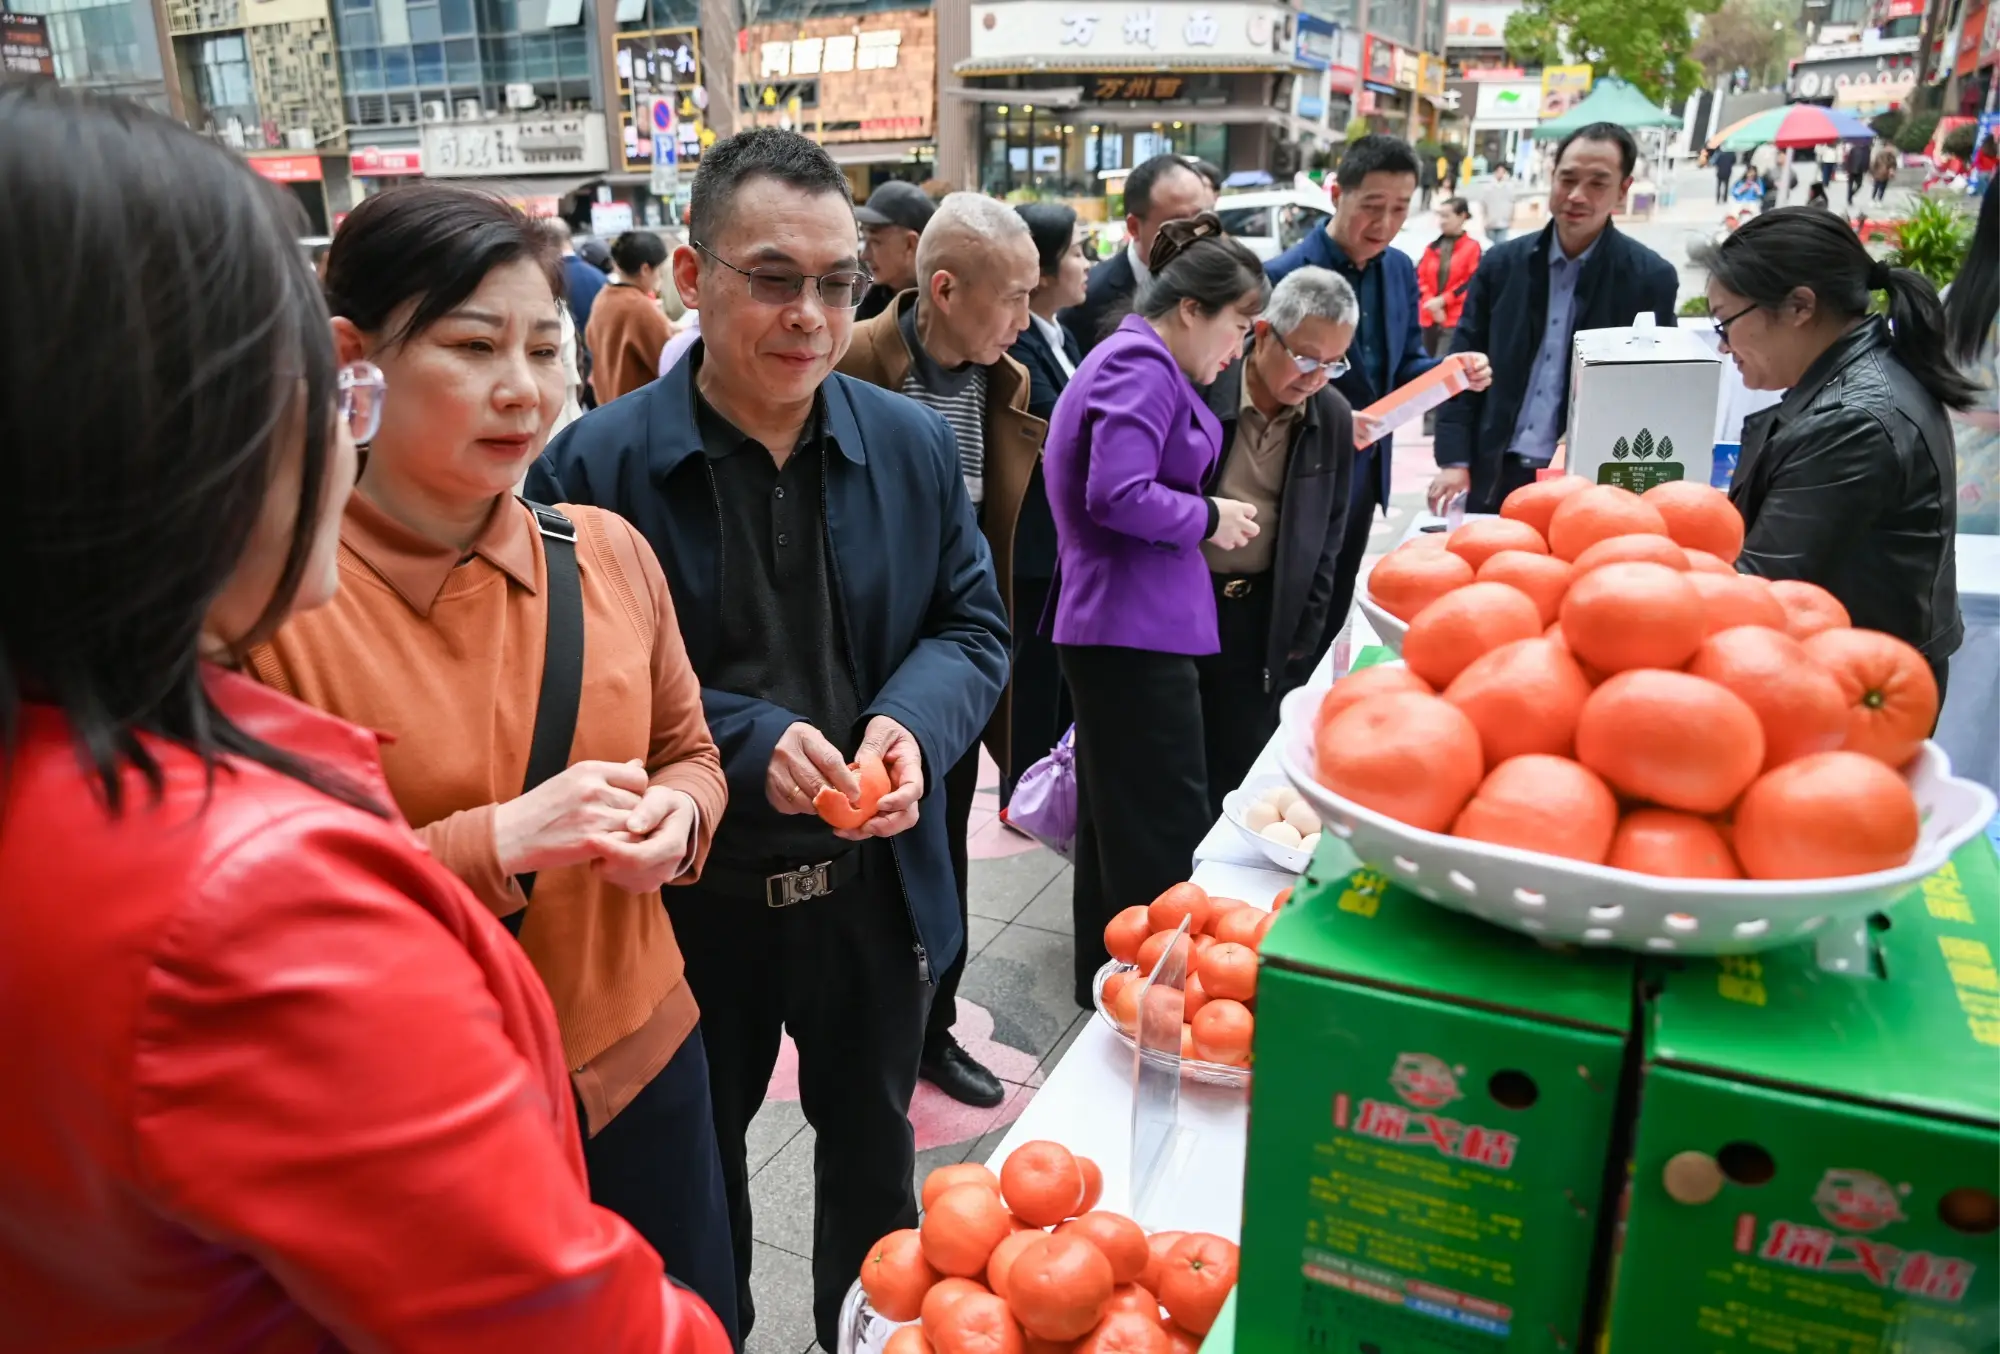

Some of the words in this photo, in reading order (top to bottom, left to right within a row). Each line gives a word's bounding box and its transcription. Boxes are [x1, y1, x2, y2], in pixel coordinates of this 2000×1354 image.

[1060, 9, 1220, 50] 万州面
[1095, 78, 1182, 97] 万州面
